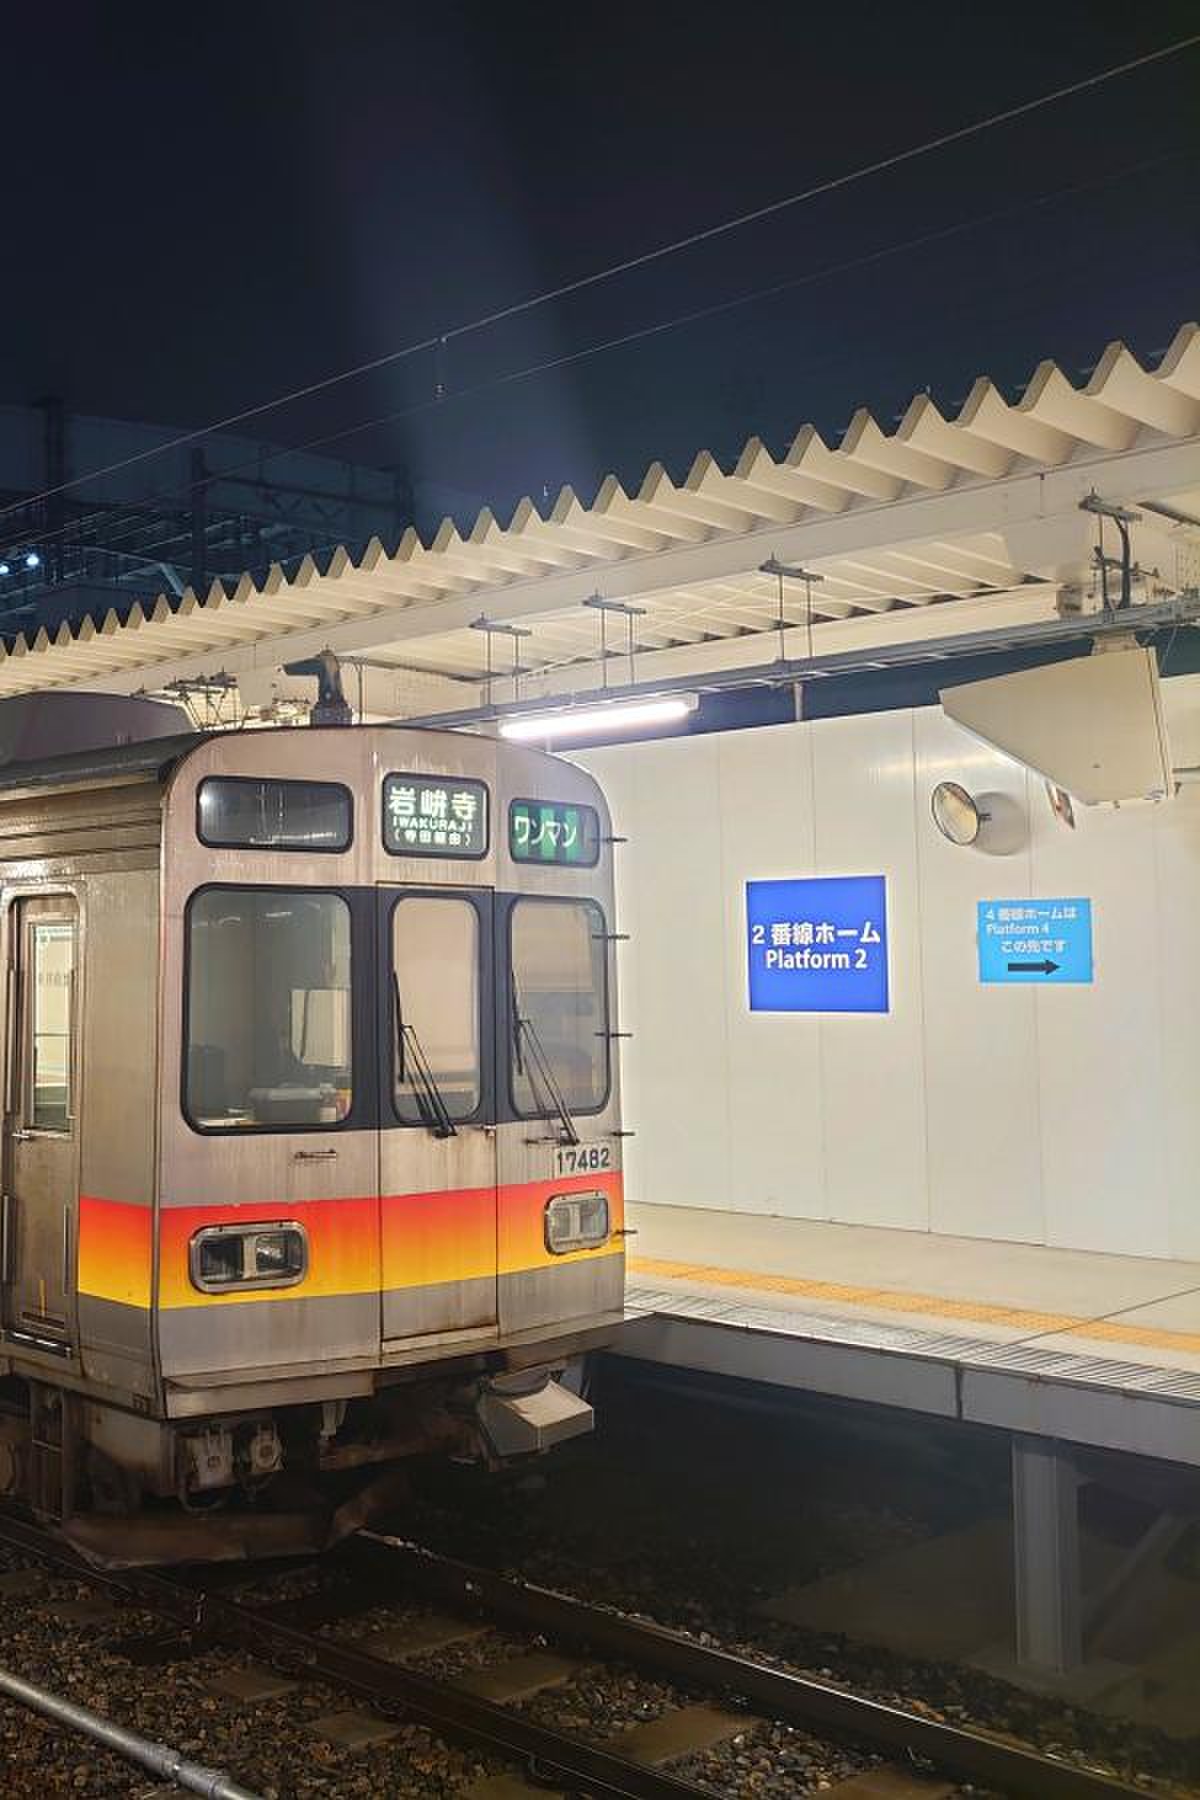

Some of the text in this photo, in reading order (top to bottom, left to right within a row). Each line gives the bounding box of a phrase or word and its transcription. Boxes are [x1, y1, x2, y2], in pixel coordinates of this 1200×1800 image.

[389, 786, 477, 820] 岩峅寺
[393, 816, 472, 832] IWAKURAJI
[514, 815, 577, 848] ワンマン
[752, 921, 881, 946] 2 番線ホーム
[987, 924, 1038, 936] Platform
[766, 949, 868, 970] Platform 2
[558, 1148, 609, 1174] 17482
